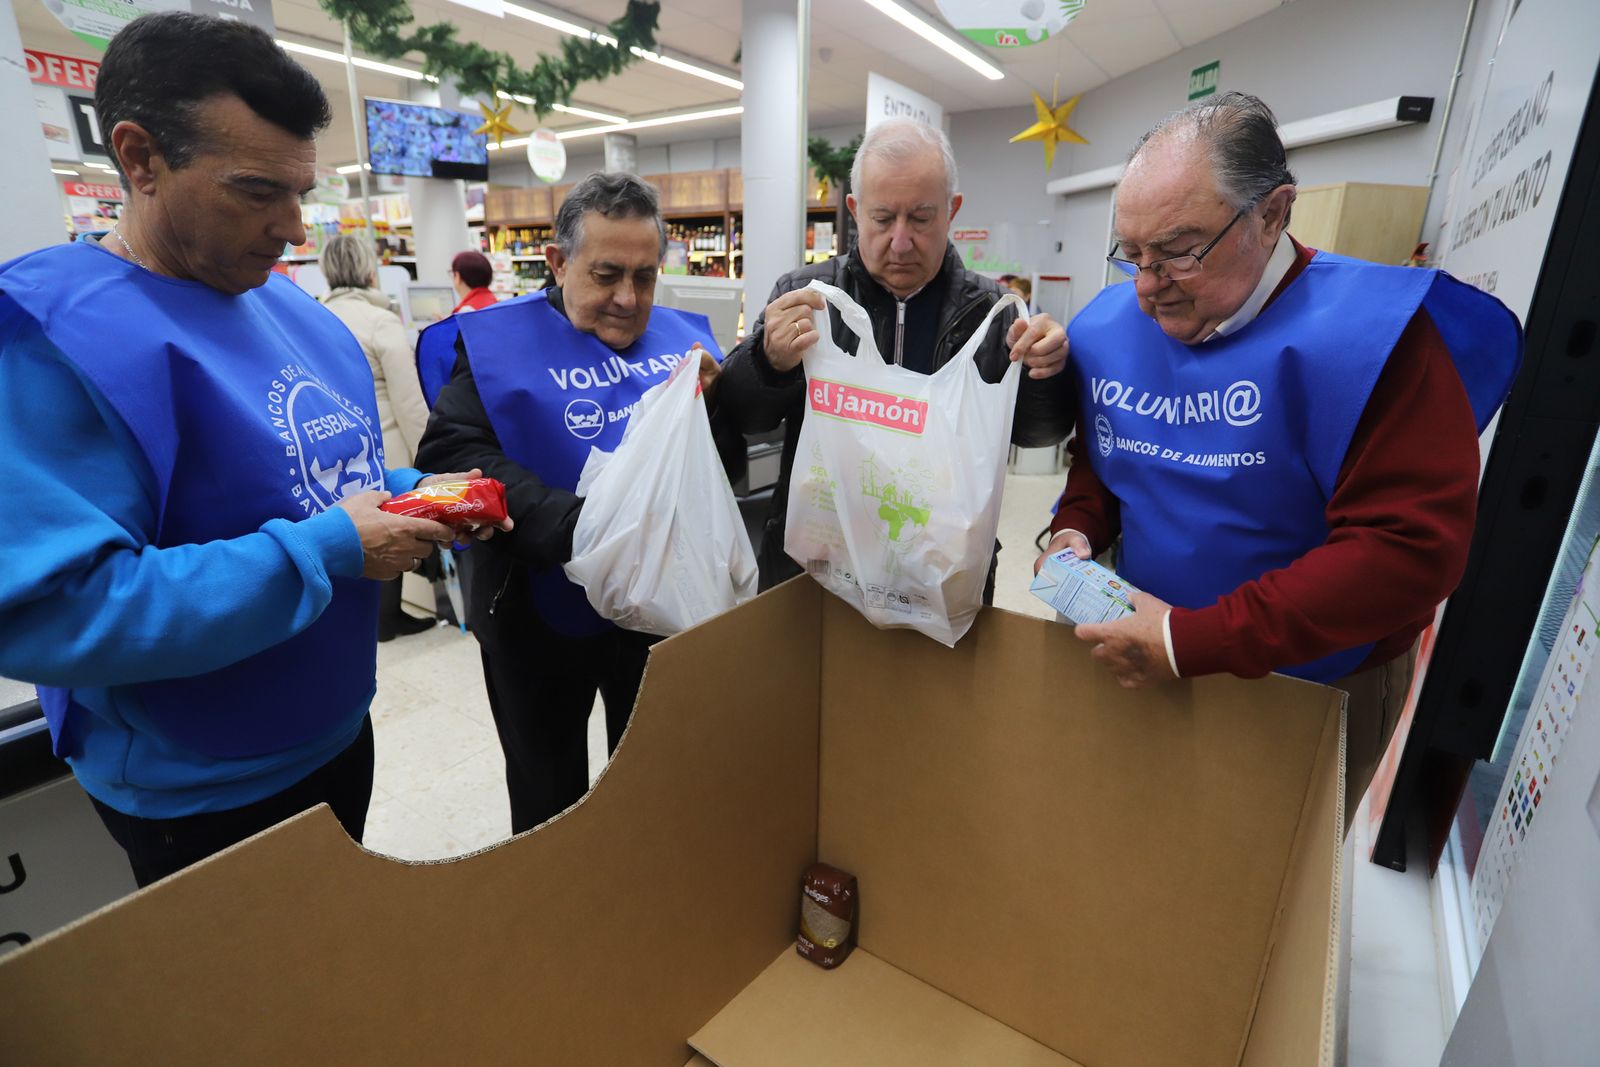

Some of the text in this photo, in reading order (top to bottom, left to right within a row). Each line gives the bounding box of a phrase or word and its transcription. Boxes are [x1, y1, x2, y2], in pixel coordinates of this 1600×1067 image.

[813, 384, 920, 426] el jamón
[1091, 377, 1263, 427] VOLUNTARI@
[302, 411, 357, 444] FESBAL
[1115, 437, 1267, 468] BANCOS DE ALIMENTOS
